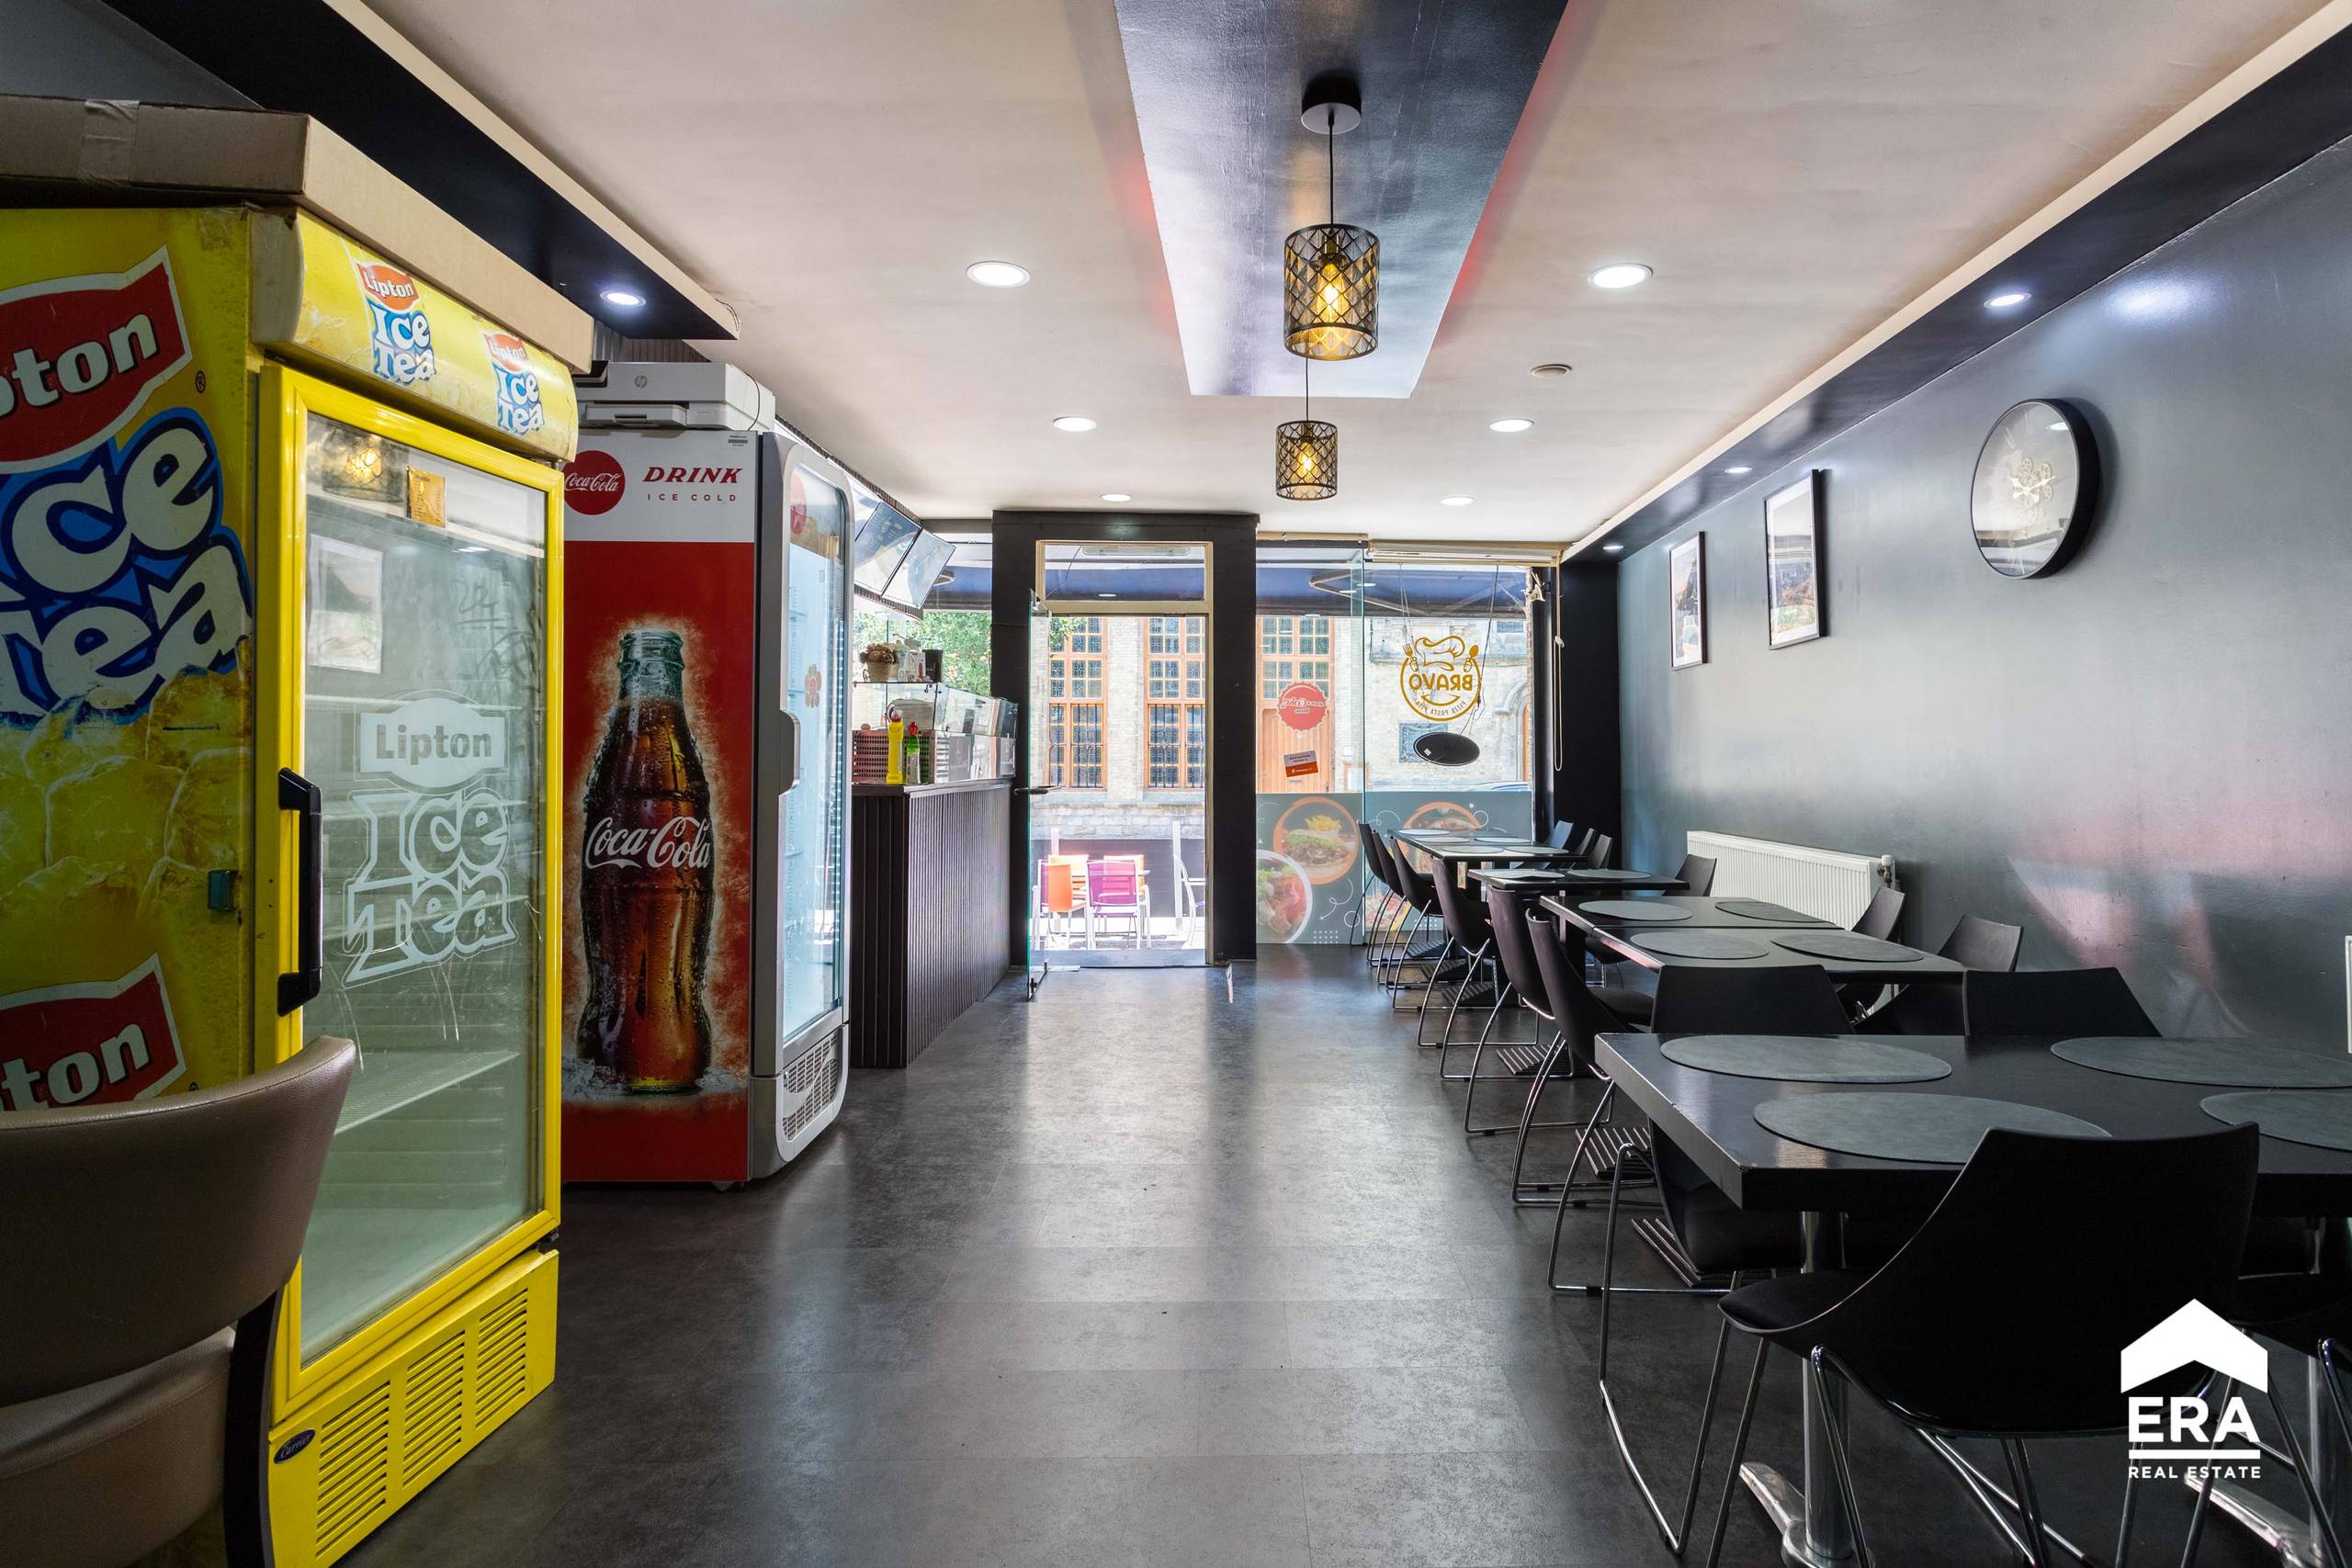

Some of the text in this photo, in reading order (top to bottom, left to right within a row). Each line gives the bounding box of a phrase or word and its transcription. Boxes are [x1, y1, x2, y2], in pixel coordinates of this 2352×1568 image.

[362, 271, 414, 299] Lipton
[369, 303, 430, 349] Ice
[0, 313, 157, 415] ton
[373, 338, 436, 382] Tea
[492, 342, 528, 363] Lipton
[495, 367, 539, 404] Ice
[497, 398, 544, 434] Tea
[565, 472, 622, 491] Coca-Cola
[642, 466, 742, 484] DRINK
[0, 427, 214, 595] ce
[647, 492, 737, 502] ICE COLD
[376, 724, 492, 765] Lipton
[352, 791, 508, 874] Ice
[584, 816, 711, 869] Coca-Cola
[345, 873, 516, 983] Tea
